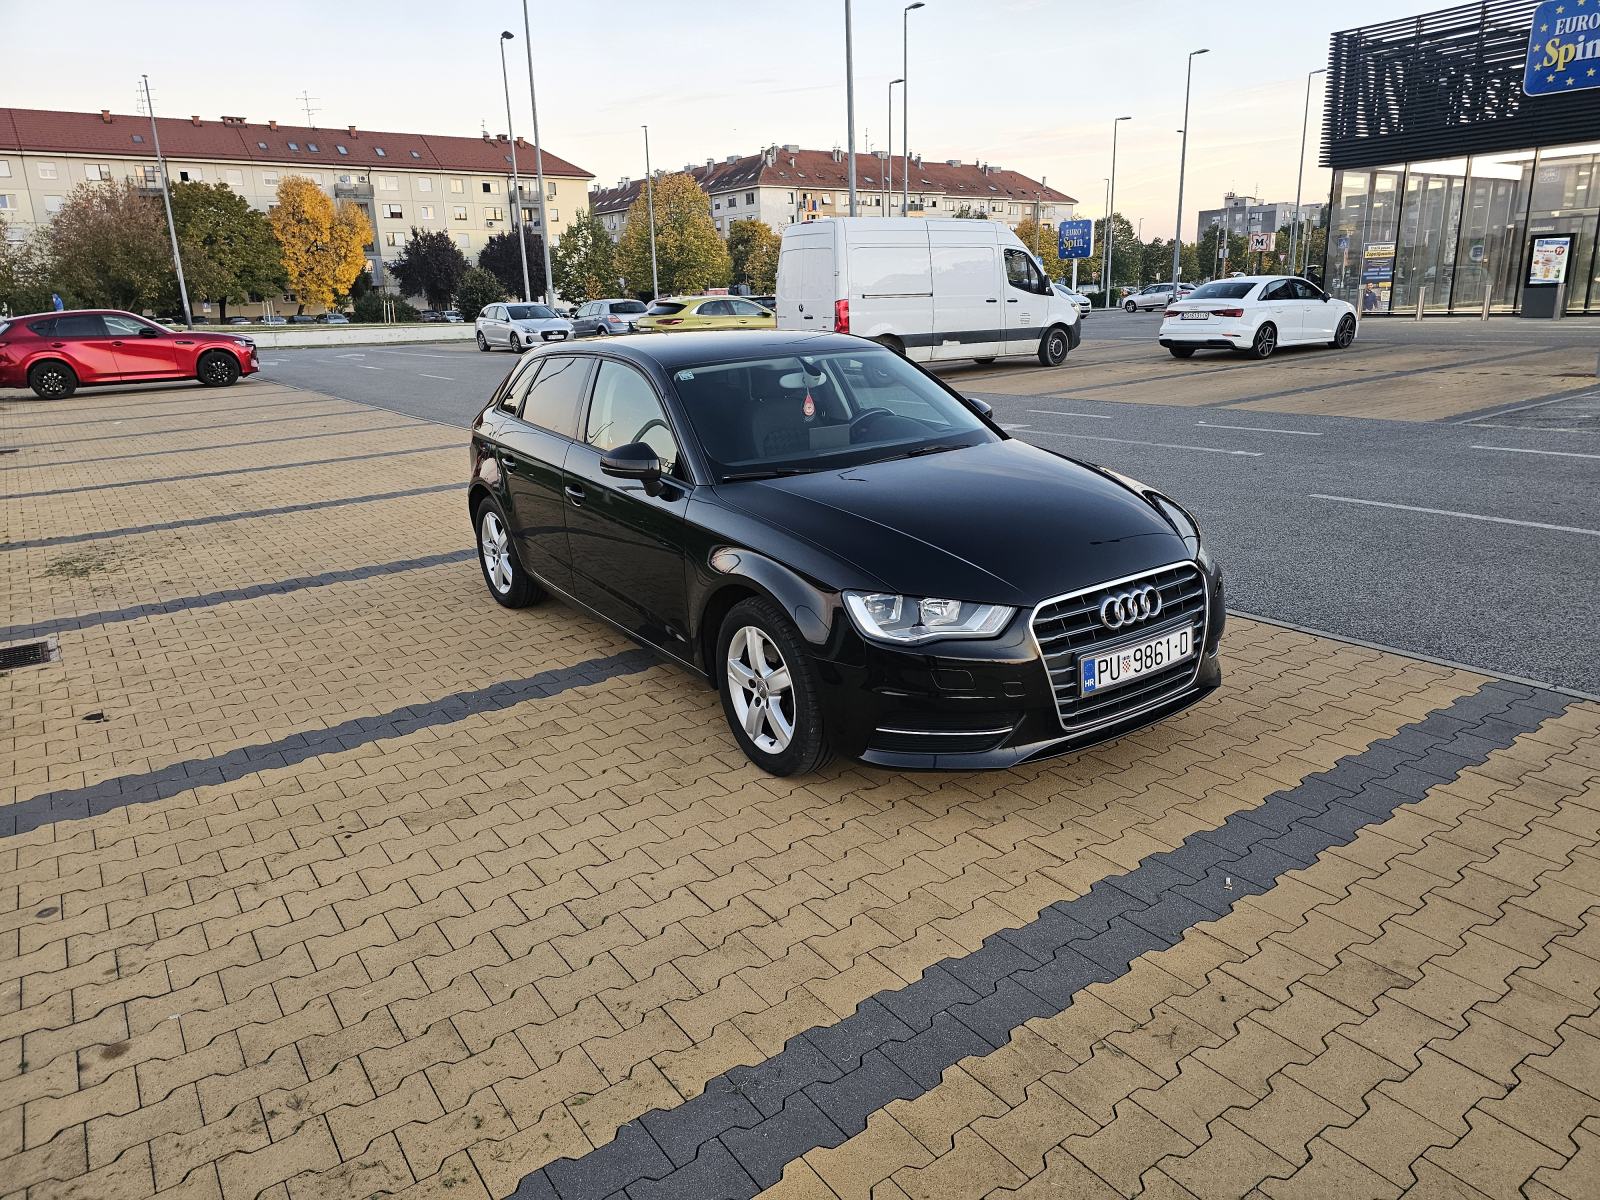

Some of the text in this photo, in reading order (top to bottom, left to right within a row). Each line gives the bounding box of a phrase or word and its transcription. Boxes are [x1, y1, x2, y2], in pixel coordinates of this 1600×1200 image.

[1554, 12, 1600, 36] EURO
[1542, 35, 1600, 72] Spin
[1066, 228, 1082, 237] EURO
[1063, 236, 1084, 251] Spin
[1098, 631, 1188, 685] PU 9861-D
[1084, 678, 1095, 688] HR
